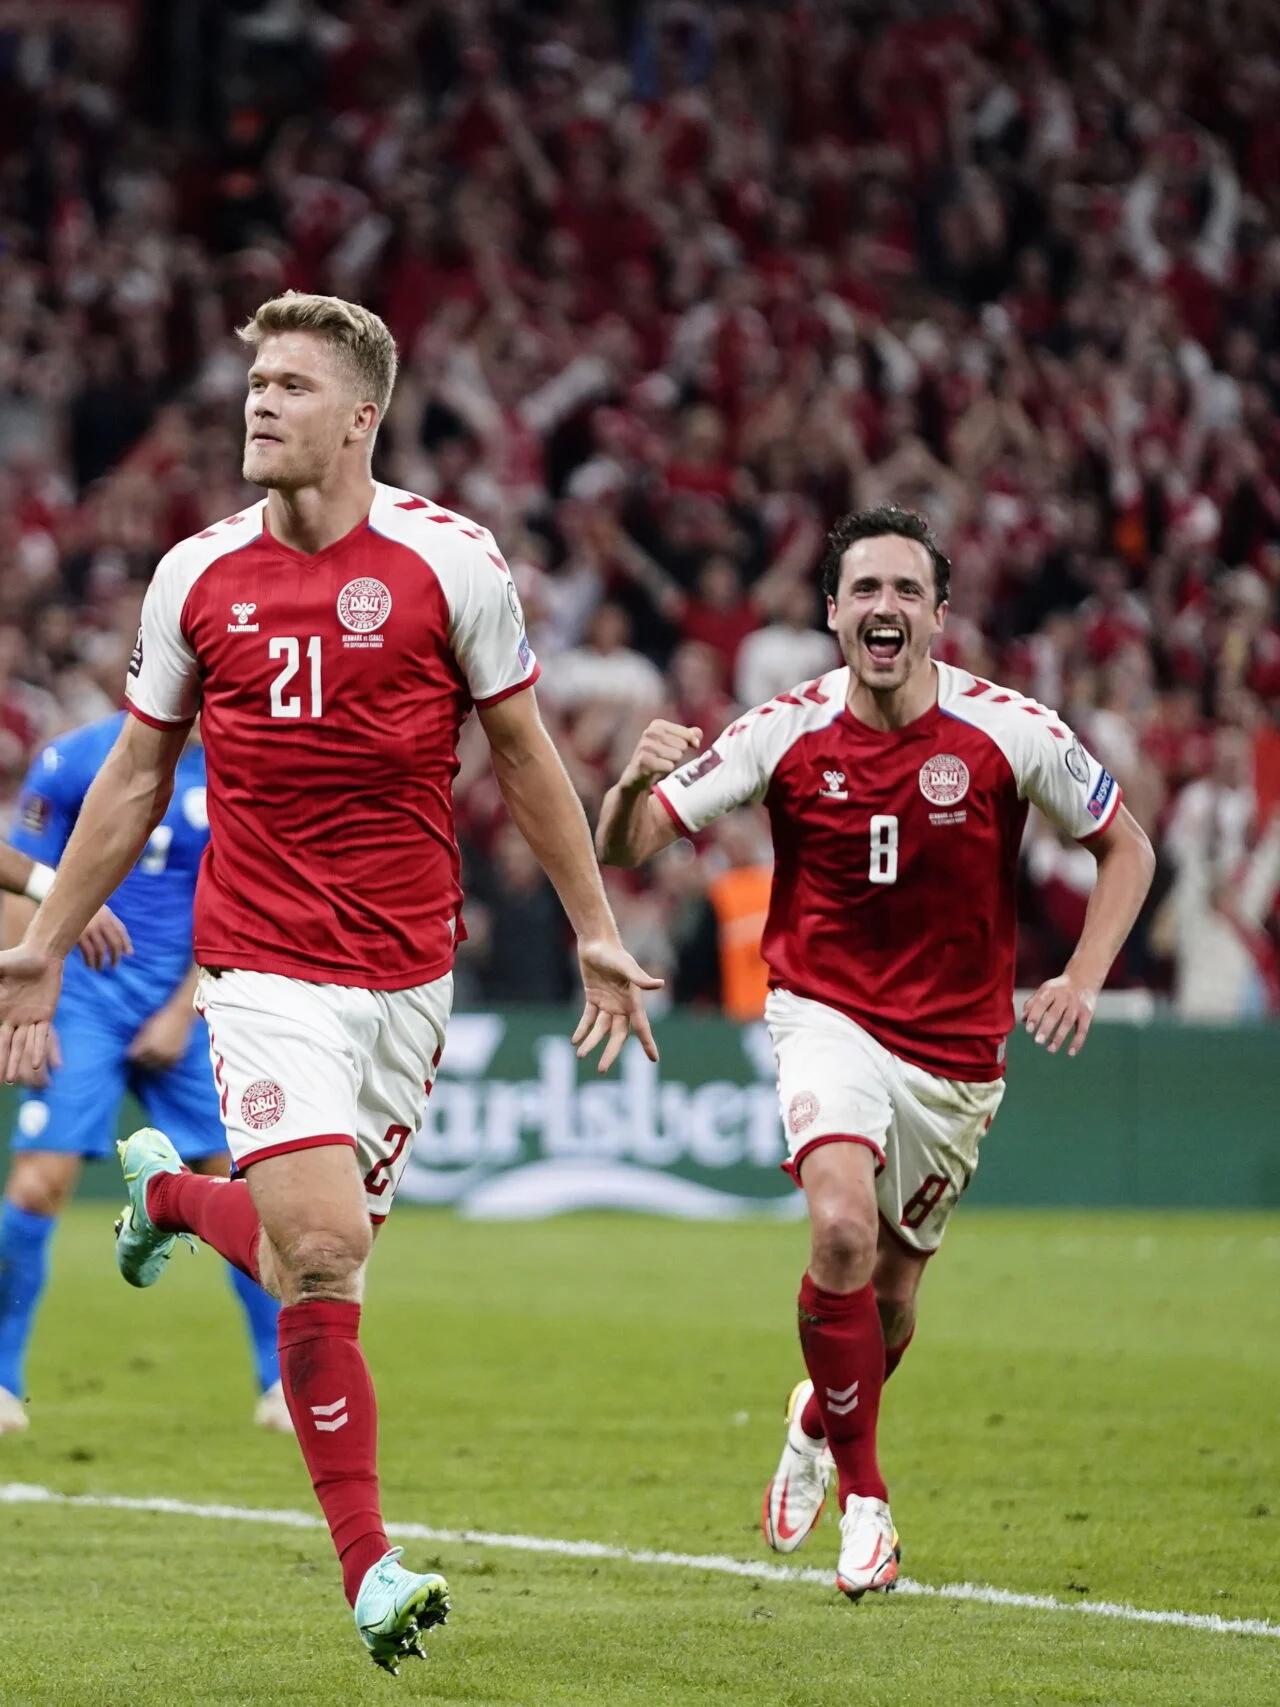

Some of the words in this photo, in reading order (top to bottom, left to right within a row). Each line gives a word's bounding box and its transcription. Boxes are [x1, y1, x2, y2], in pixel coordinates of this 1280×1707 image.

[349, 595, 380, 612] DBU
[269, 636, 322, 718] 21
[930, 770, 959, 786] DBU
[868, 814, 899, 884] 8
[249, 1094, 278, 1116] DBU
[364, 1124, 412, 1197] 2
[900, 1173, 950, 1229] 8
